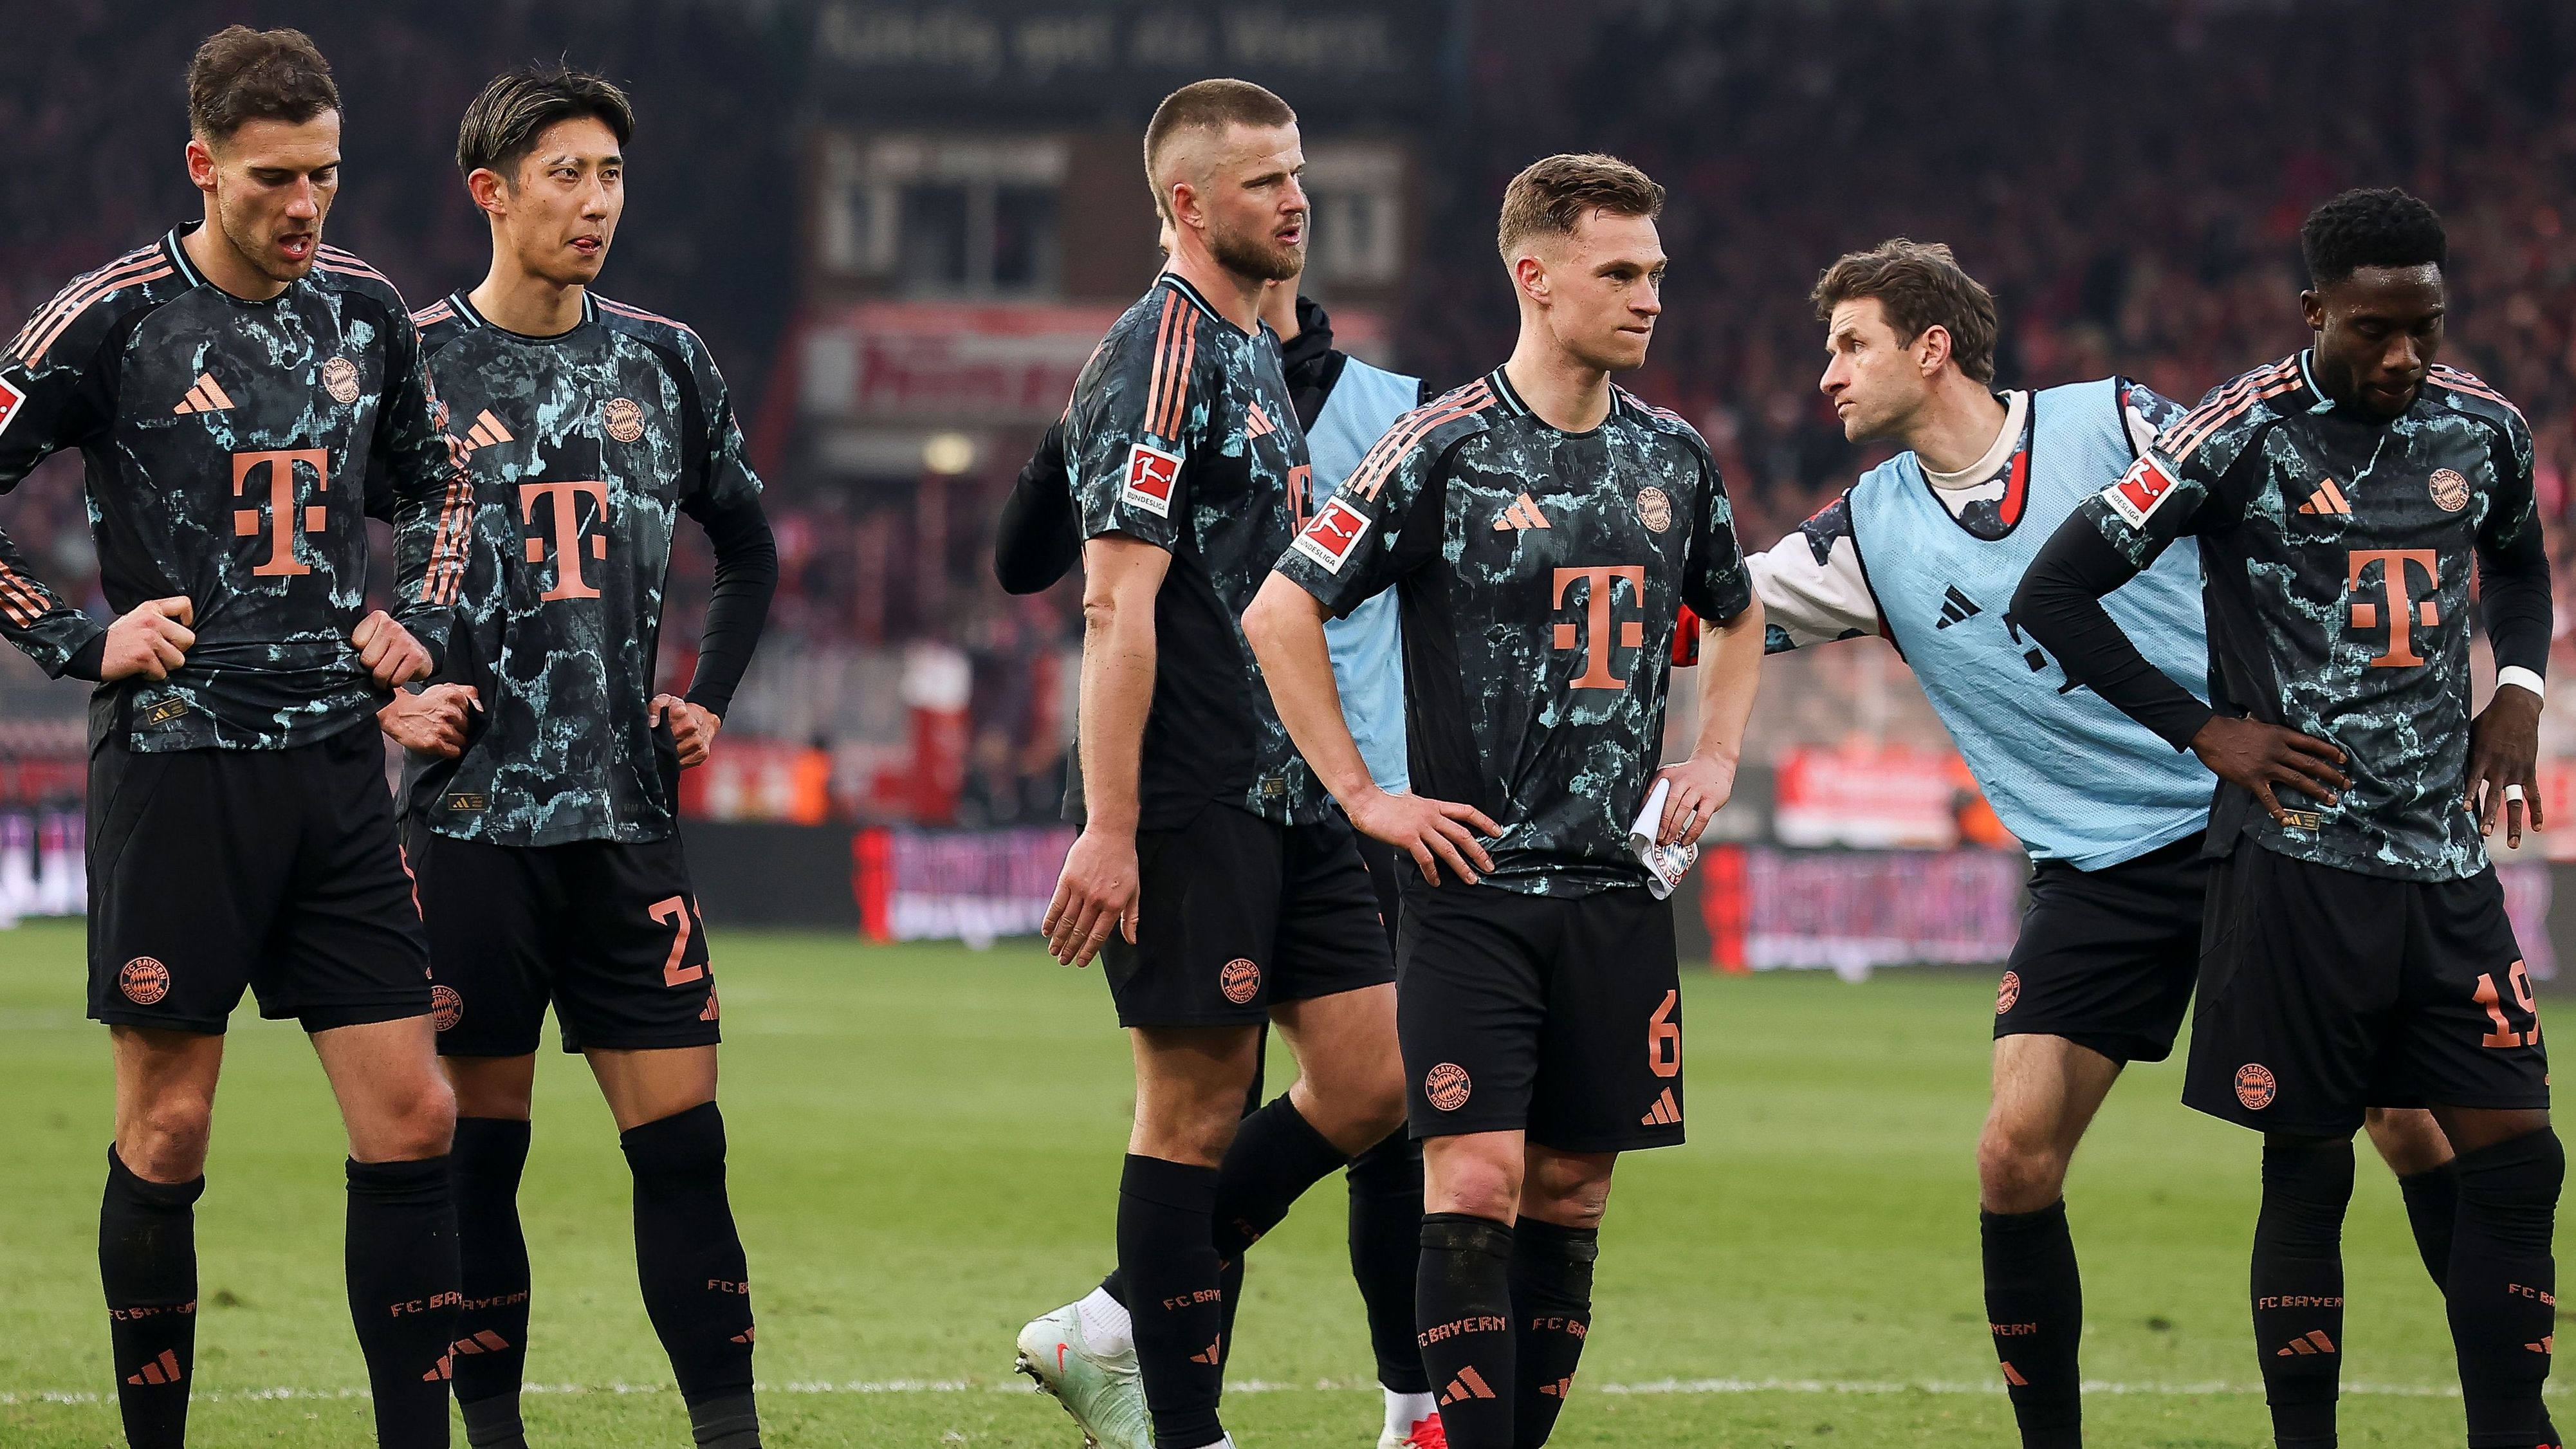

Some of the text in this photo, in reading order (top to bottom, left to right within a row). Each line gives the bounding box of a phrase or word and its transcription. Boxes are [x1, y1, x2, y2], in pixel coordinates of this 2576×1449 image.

[331, 360, 356, 377] BAYERN
[613, 401, 640, 418] BAYERN
[2436, 472, 2465, 486] BAYERN
[1127, 492, 1165, 511] BUNDESLIGA
[1645, 490, 1668, 508] BAYERN
[2110, 490, 2140, 522] NDESLIGA
[1298, 538, 1336, 566] BUNDESLIGA
[649, 892, 713, 987] 2
[136, 959, 167, 980] BAYERN
[1231, 961, 1258, 977] BAYERN
[2472, 959, 2539, 1047] 19
[1649, 989, 1680, 1077] 6
[1435, 1066, 1466, 1082] BAYERN
[2248, 1066, 2274, 1088] BAYERN
[708, 1279, 733, 1293] FC
[2509, 1284, 2535, 1298] FC
[391, 1291, 462, 1317] FC BAY
[463, 1290, 528, 1311] AYERN
[1163, 1289, 1221, 1311] FC BAY
[2259, 1295, 2343, 1310] FC BAYER
[1428, 1316, 1505, 1343] BAYERN
[1532, 1317, 1563, 1330] FC
[1989, 1322, 2036, 1336] YERN
